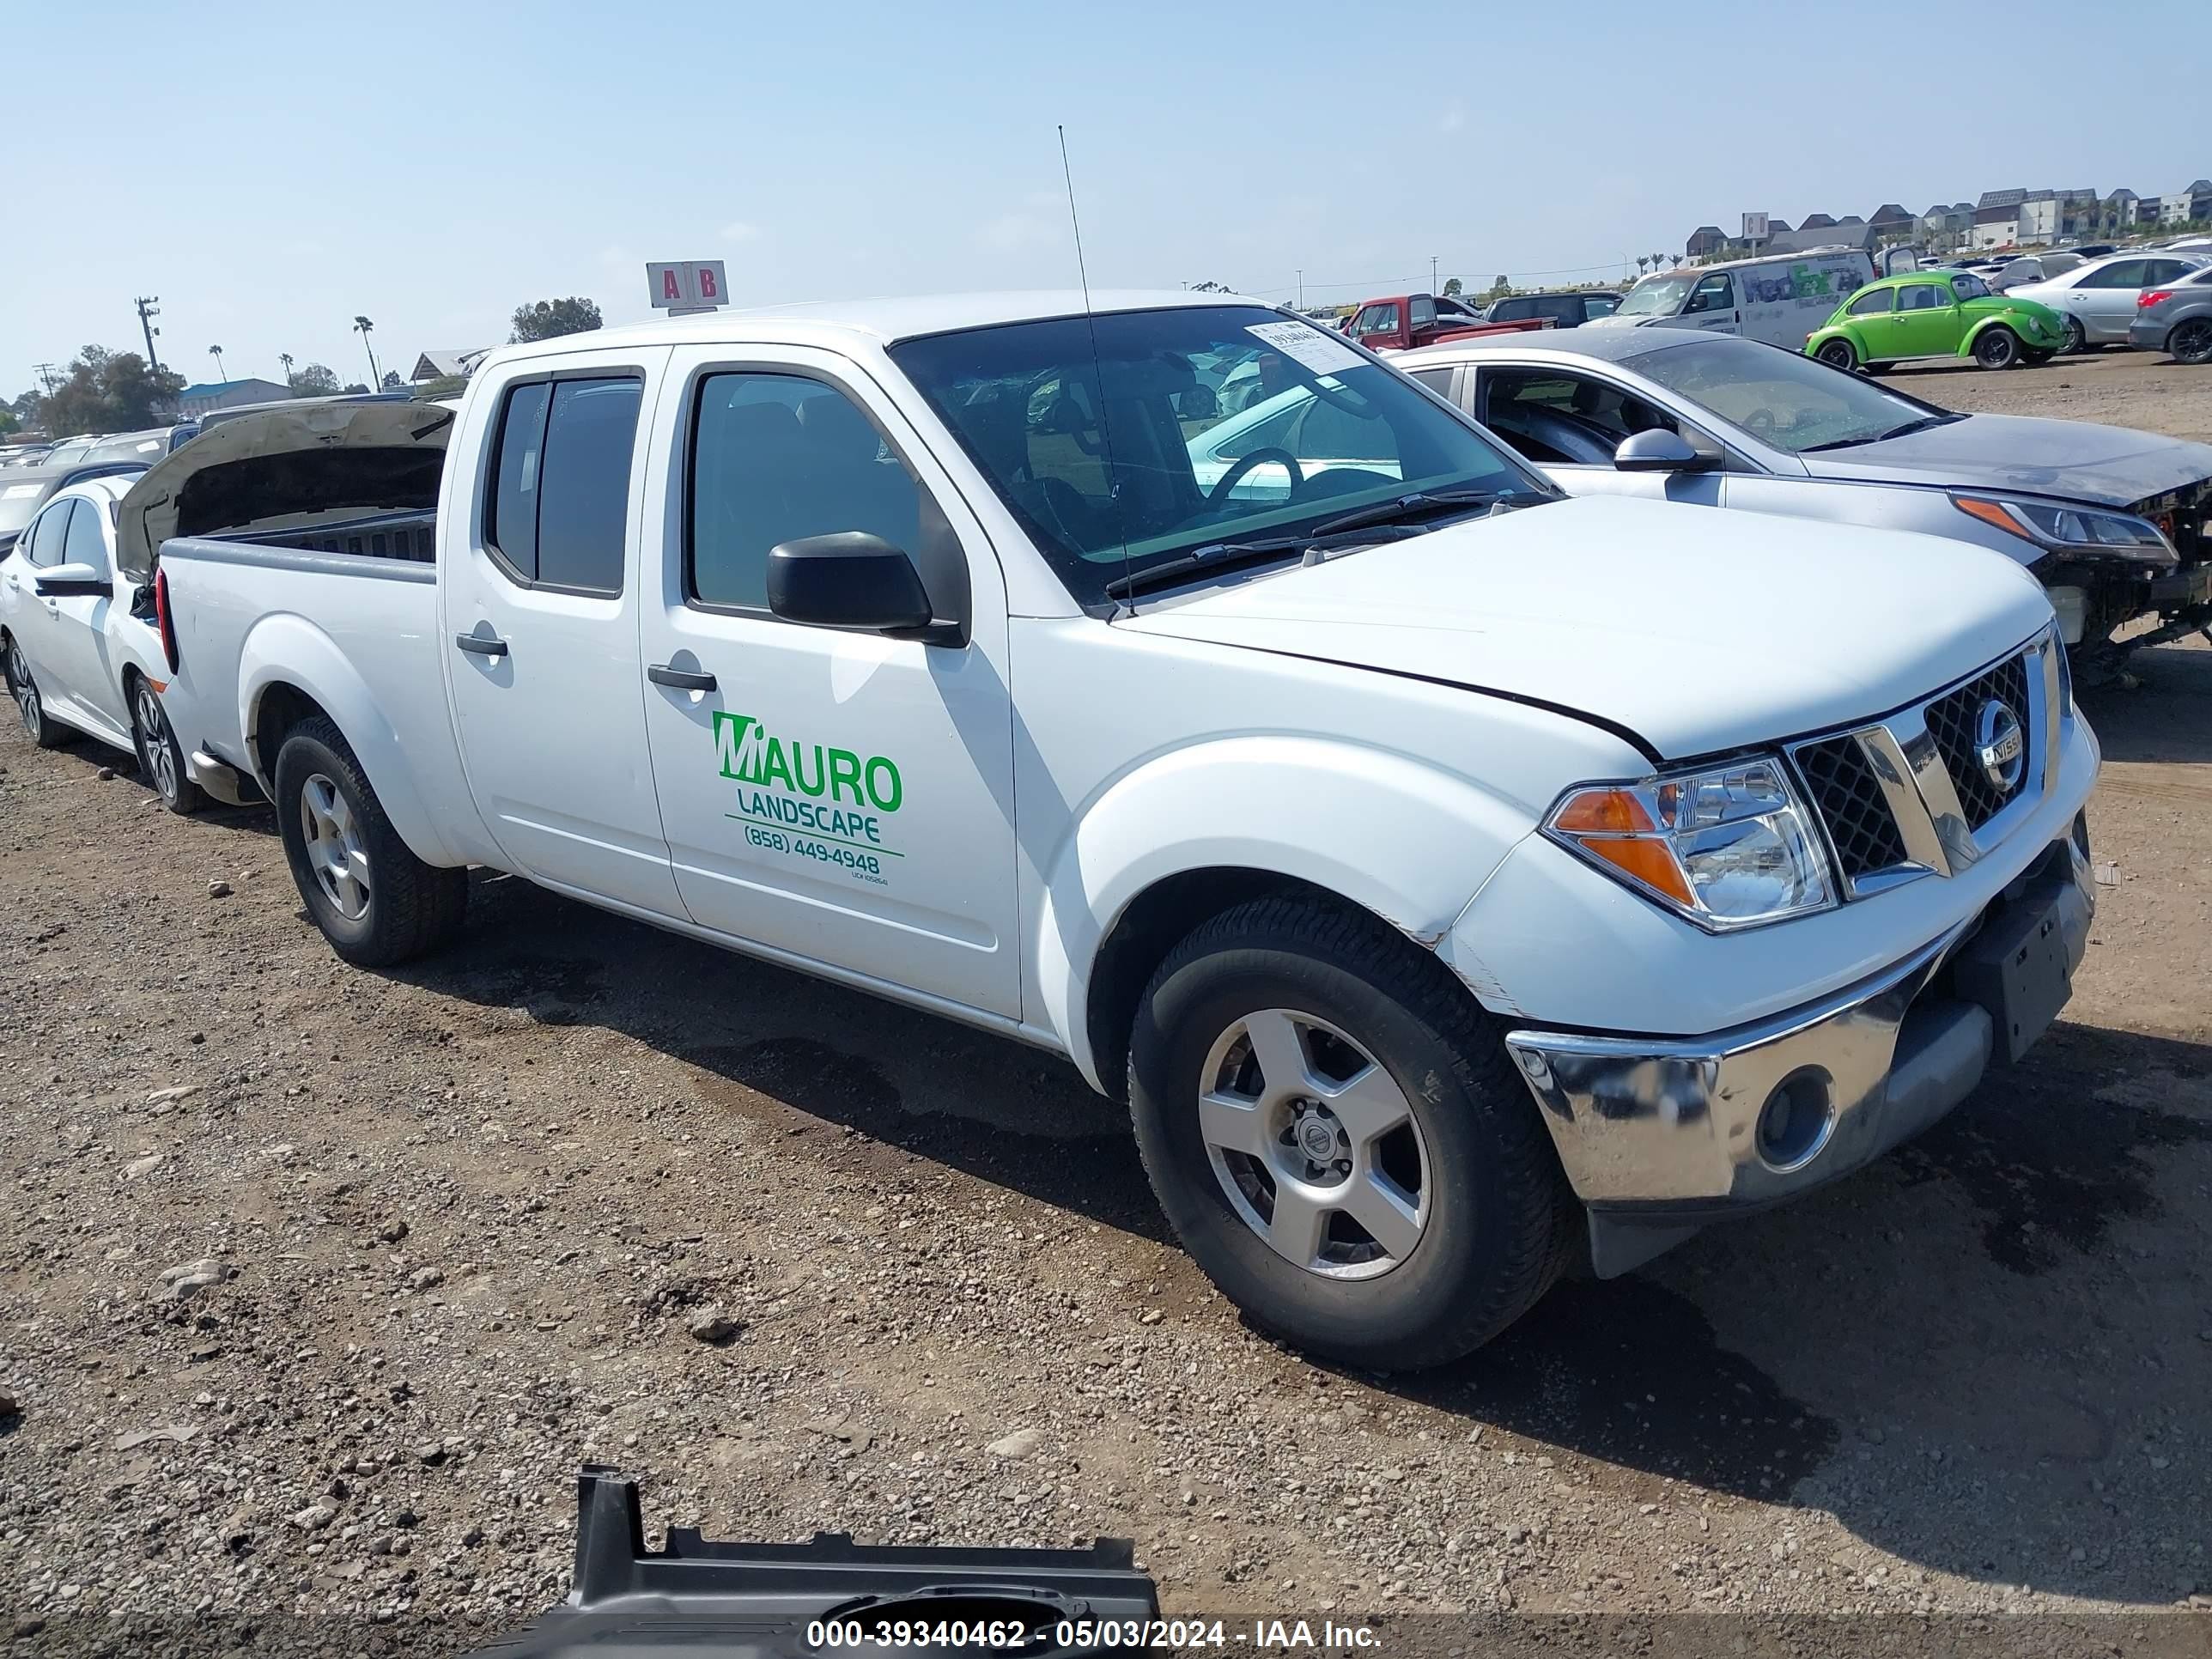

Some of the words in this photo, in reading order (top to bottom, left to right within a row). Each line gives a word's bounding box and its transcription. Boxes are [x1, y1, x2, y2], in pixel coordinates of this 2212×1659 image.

[664, 270, 680, 299] A
[699, 269, 717, 297] B
[713, 711, 902, 812] MAURO
[1993, 733, 2021, 762] NISS
[738, 788, 881, 843] LANDSCAPE
[744, 825, 790, 854] (858)
[794, 840, 880, 874] 449-4948
